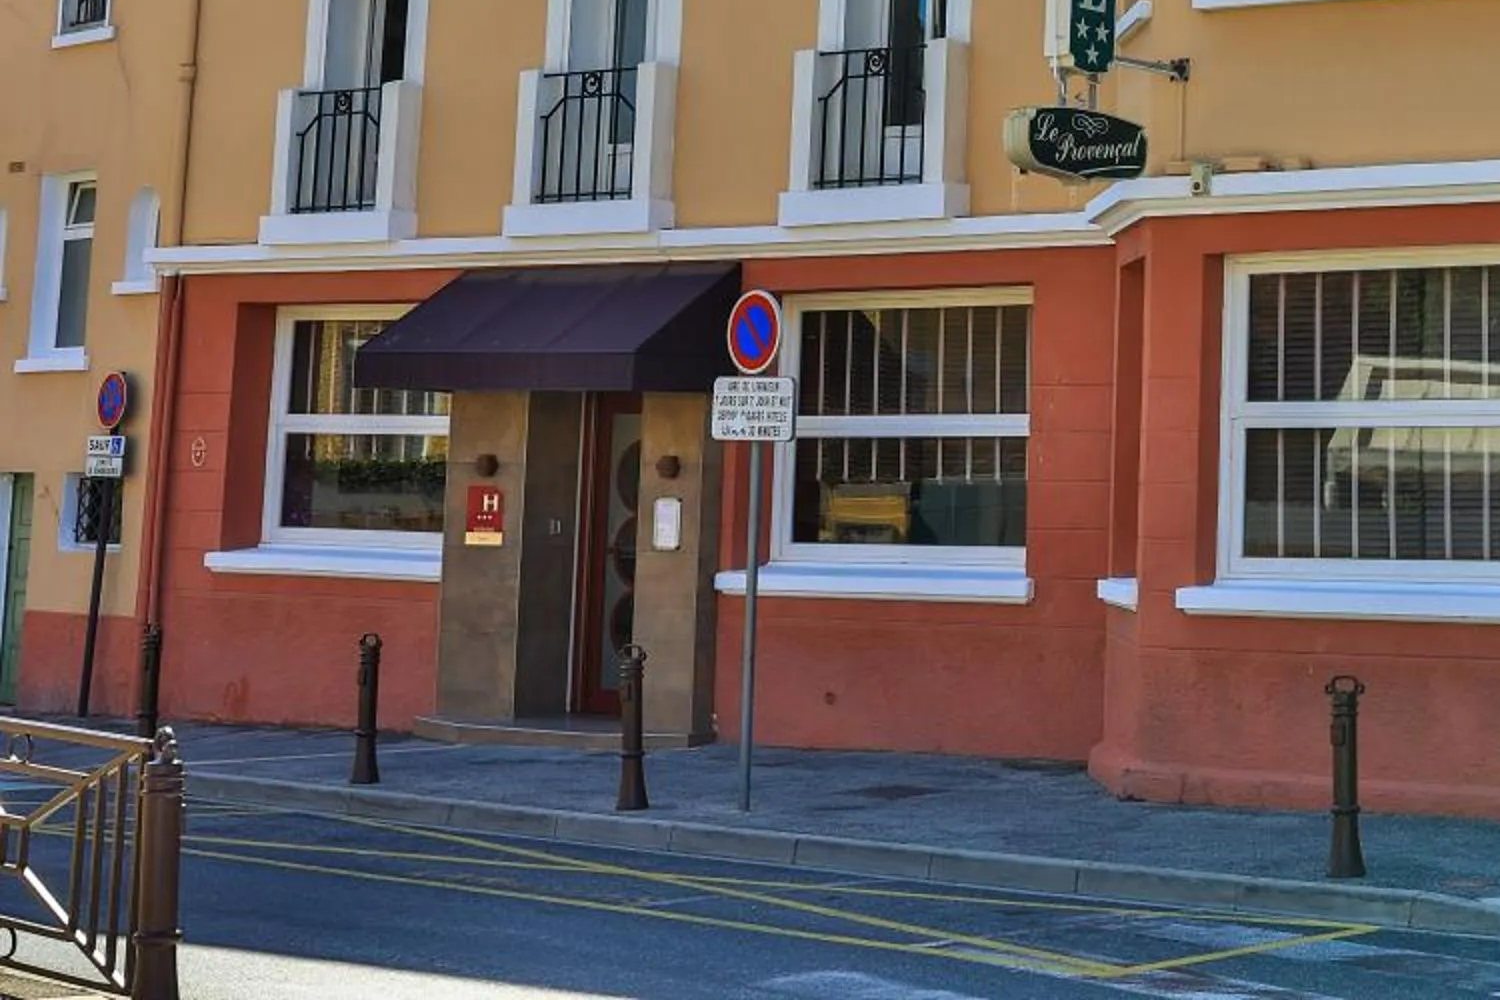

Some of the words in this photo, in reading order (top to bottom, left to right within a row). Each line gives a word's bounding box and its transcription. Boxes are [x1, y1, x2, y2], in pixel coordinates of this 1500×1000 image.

[1034, 112, 1060, 143] Le
[1055, 131, 1142, 165] Provençal
[483, 494, 499, 512] H
